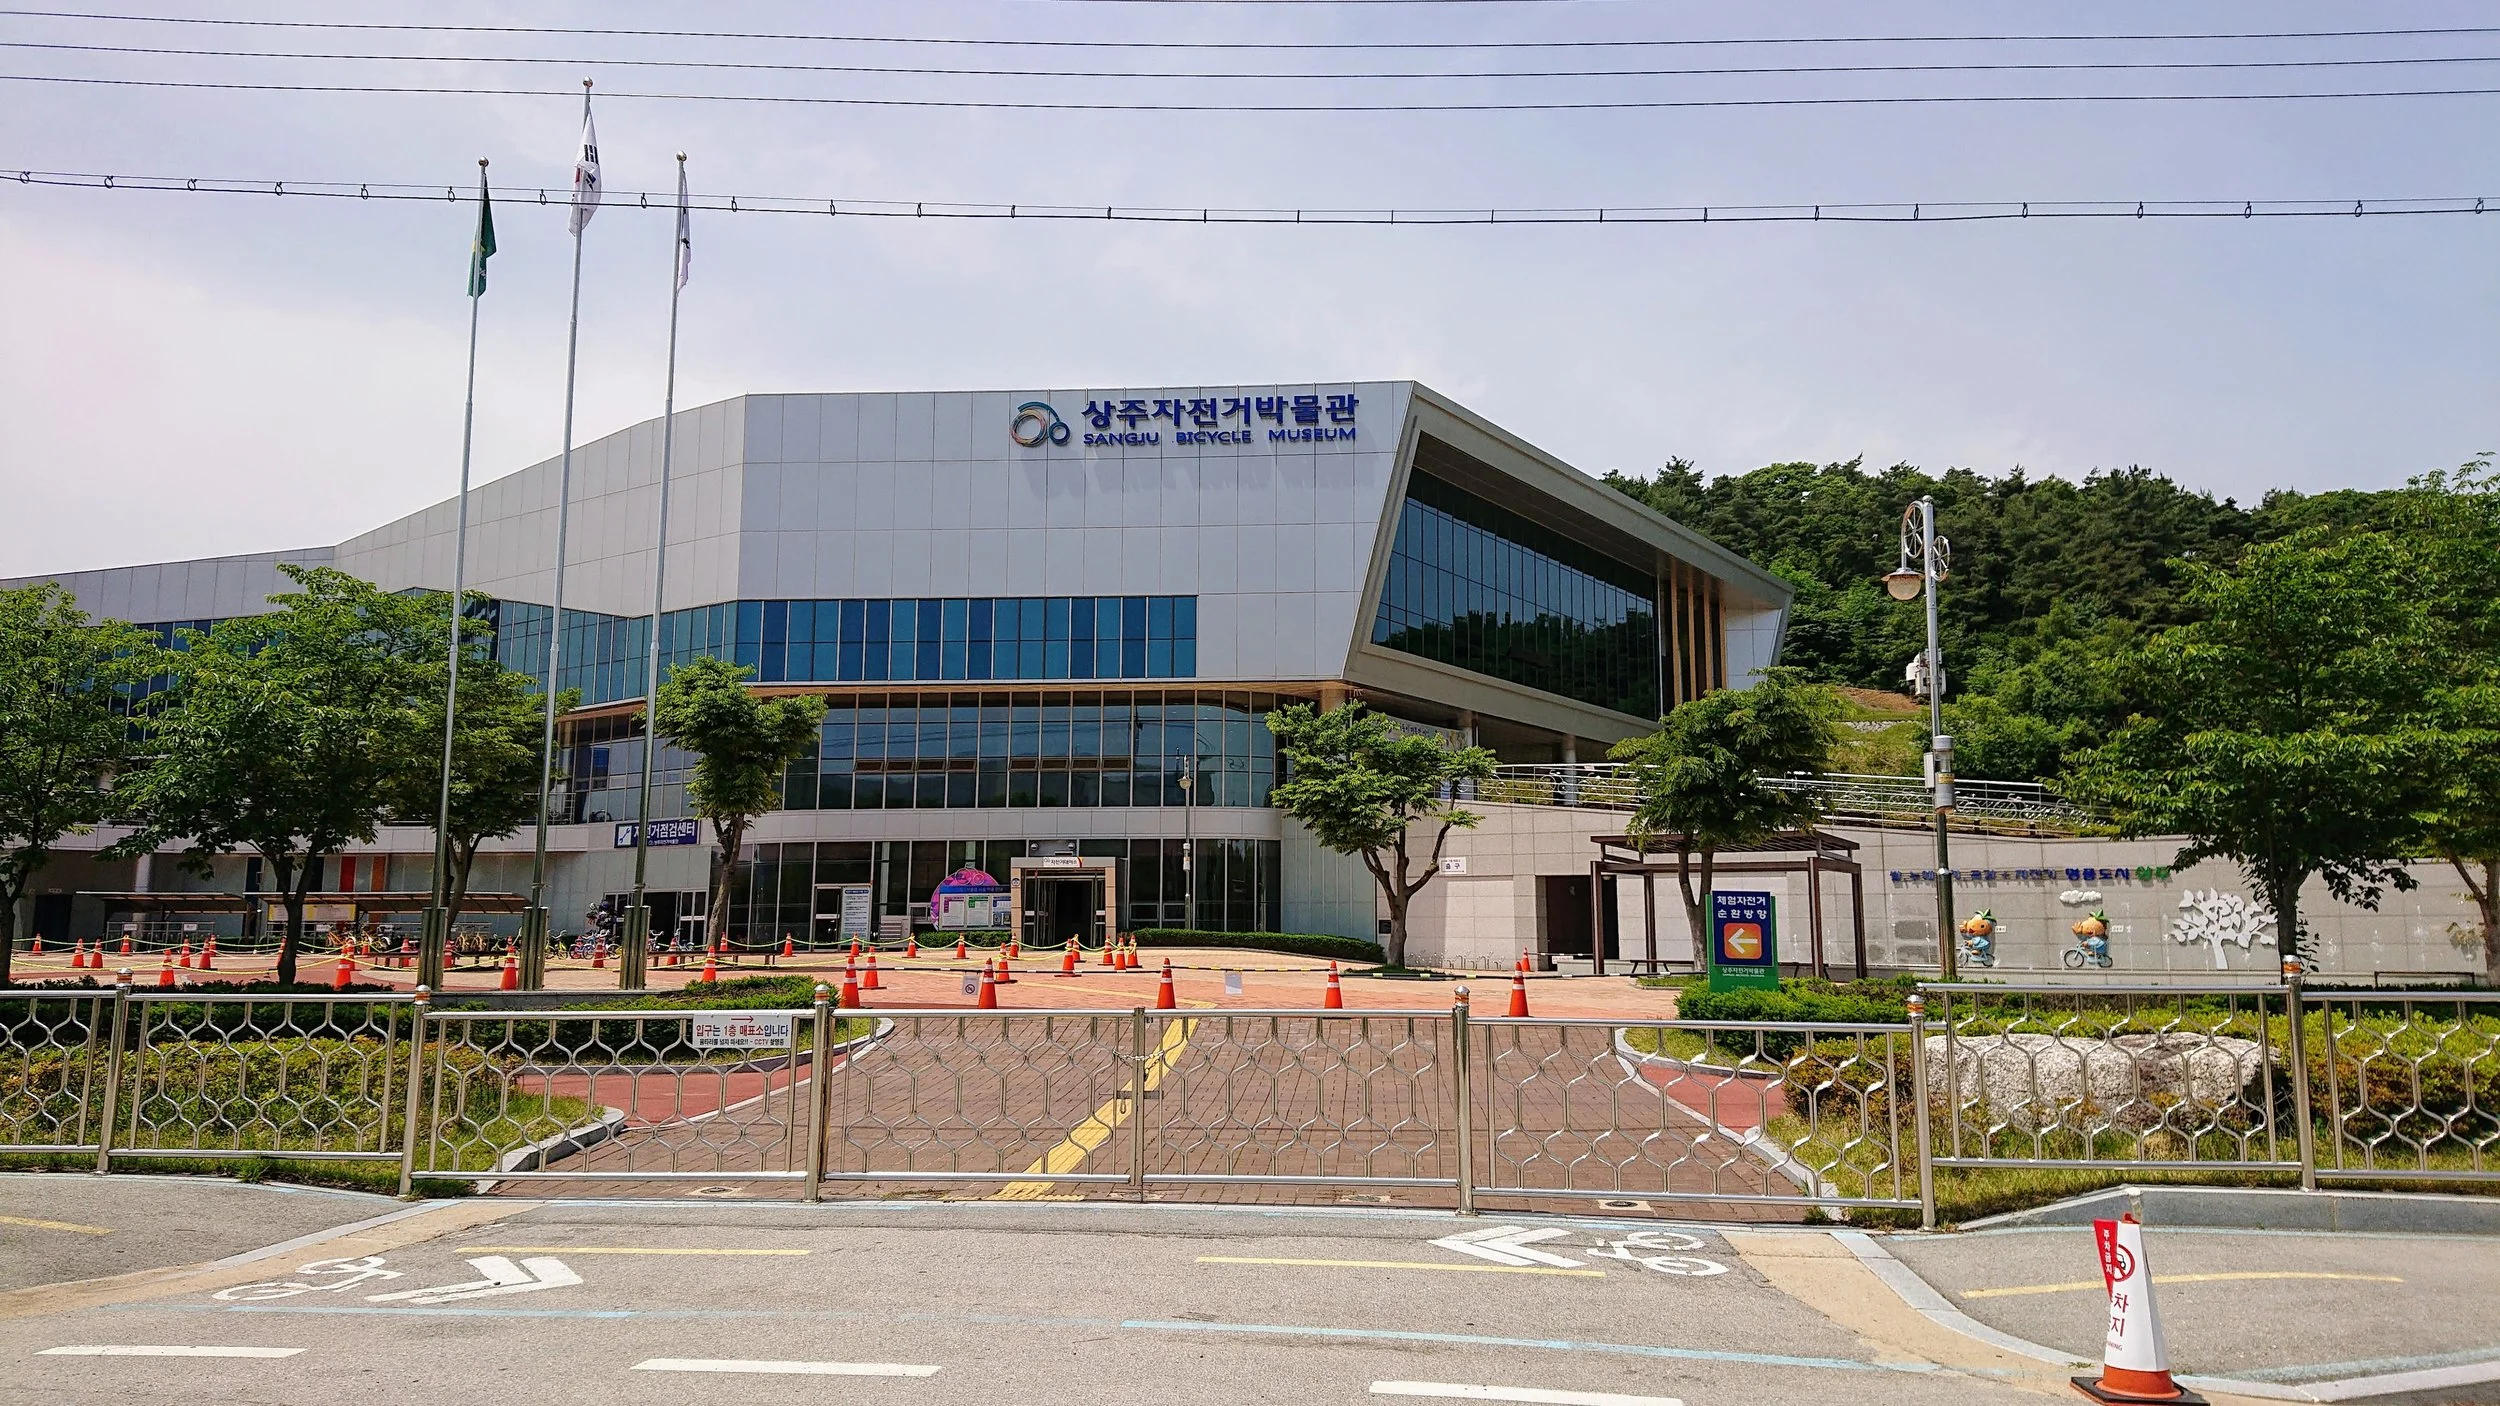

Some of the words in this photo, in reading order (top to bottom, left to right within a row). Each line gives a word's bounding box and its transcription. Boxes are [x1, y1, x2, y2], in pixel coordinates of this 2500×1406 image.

[1081, 394, 1360, 429] 상주자전거박물관
[1083, 431, 1160, 445] SANGJU
[1176, 430, 1252, 445] BICYCLE
[1268, 428, 1357, 442] MUSEUM
[1716, 895, 1766, 906] 체험자전거
[696, 1024, 721, 1037] 입구는
[724, 1024, 737, 1037] 1층
[739, 1024, 789, 1037] 매표소입니다
[754, 1038, 769, 1046] CCTV
[2103, 1229, 2113, 1275] 주차금지
